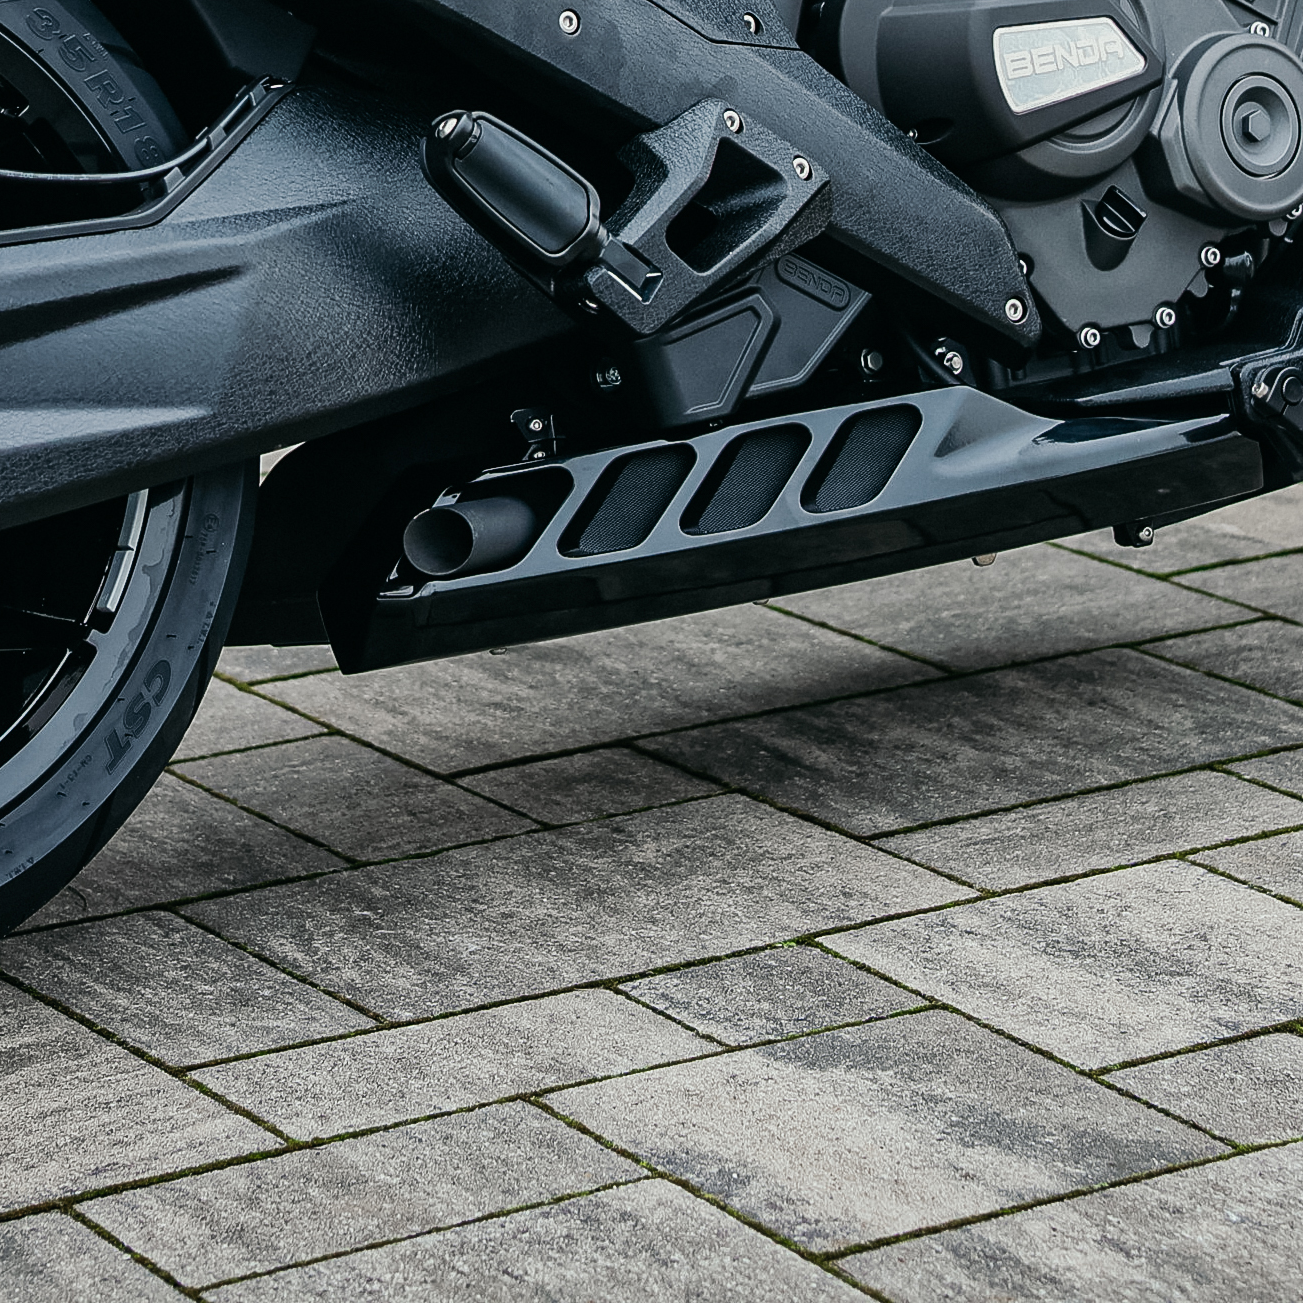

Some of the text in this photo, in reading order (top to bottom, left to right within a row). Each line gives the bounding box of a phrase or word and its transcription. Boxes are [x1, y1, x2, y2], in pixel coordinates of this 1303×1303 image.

[1003, 37, 1125, 80] BENDA
[782, 258, 846, 304] BENDA
[103, 659, 172, 776] CST
